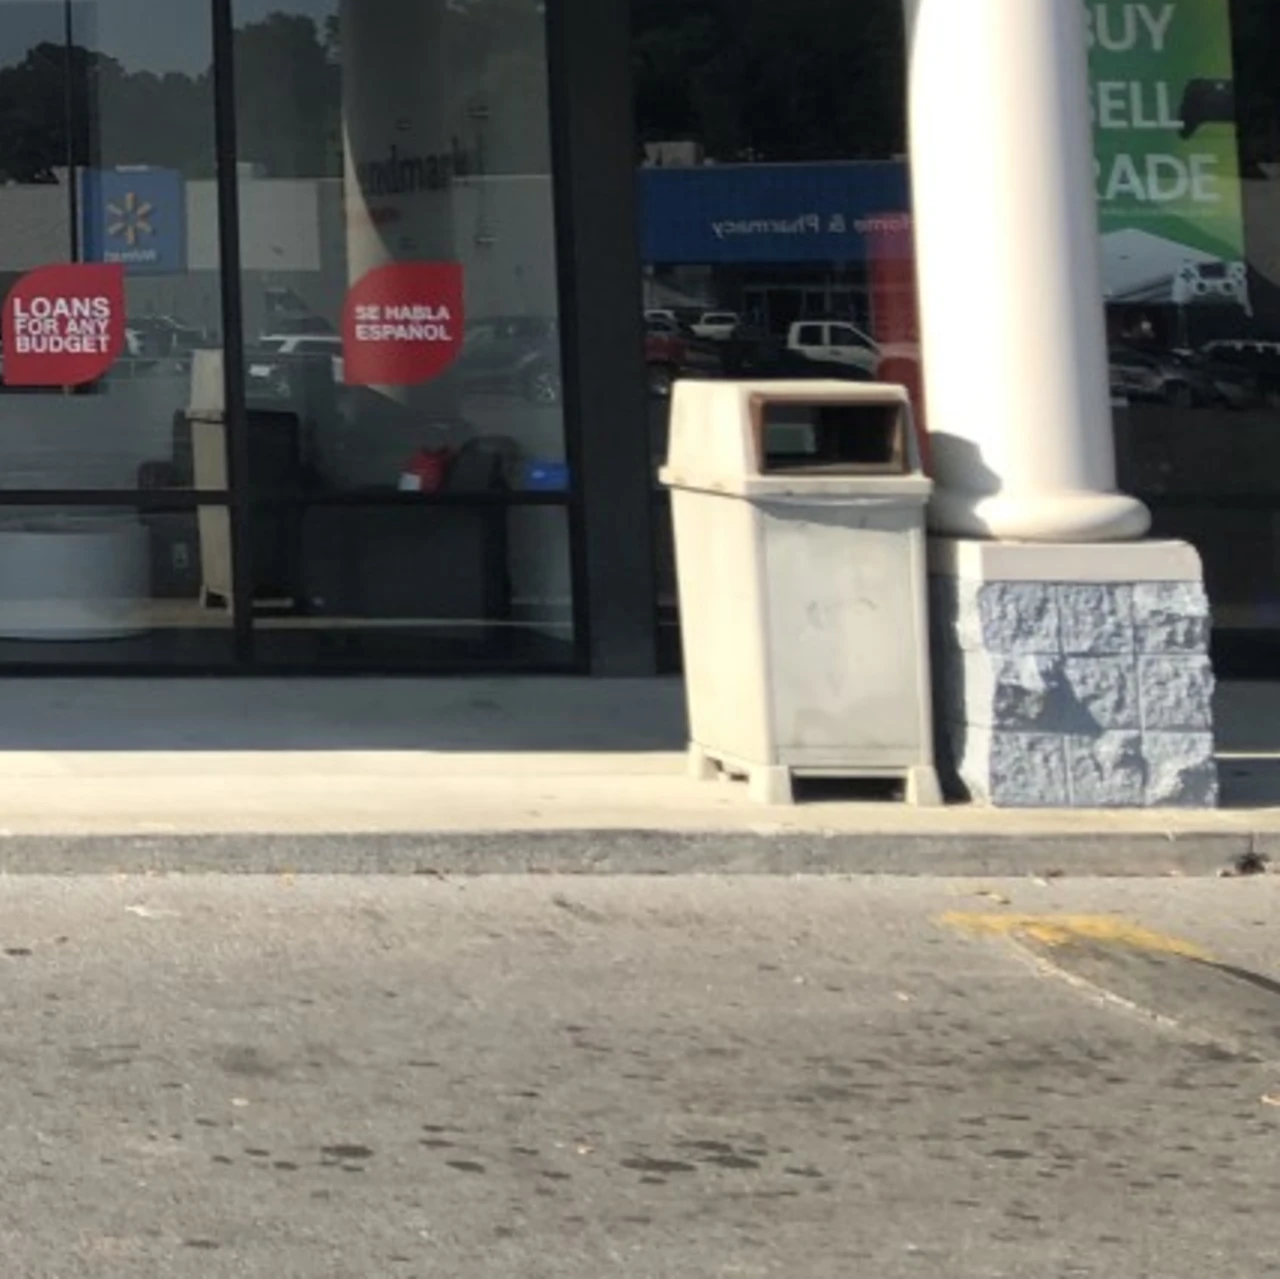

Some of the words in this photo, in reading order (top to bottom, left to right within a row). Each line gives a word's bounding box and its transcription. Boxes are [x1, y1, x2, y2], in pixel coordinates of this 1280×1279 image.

[1089, 81, 1185, 129] ELL
[1095, 153, 1221, 202] ADE
[13, 297, 110, 318] LOANS
[355, 306, 380, 320] SE
[384, 305, 451, 320] HABLA
[15, 318, 59, 335] FOR
[64, 319, 110, 335] ANY
[15, 334, 110, 353] BUDGET
